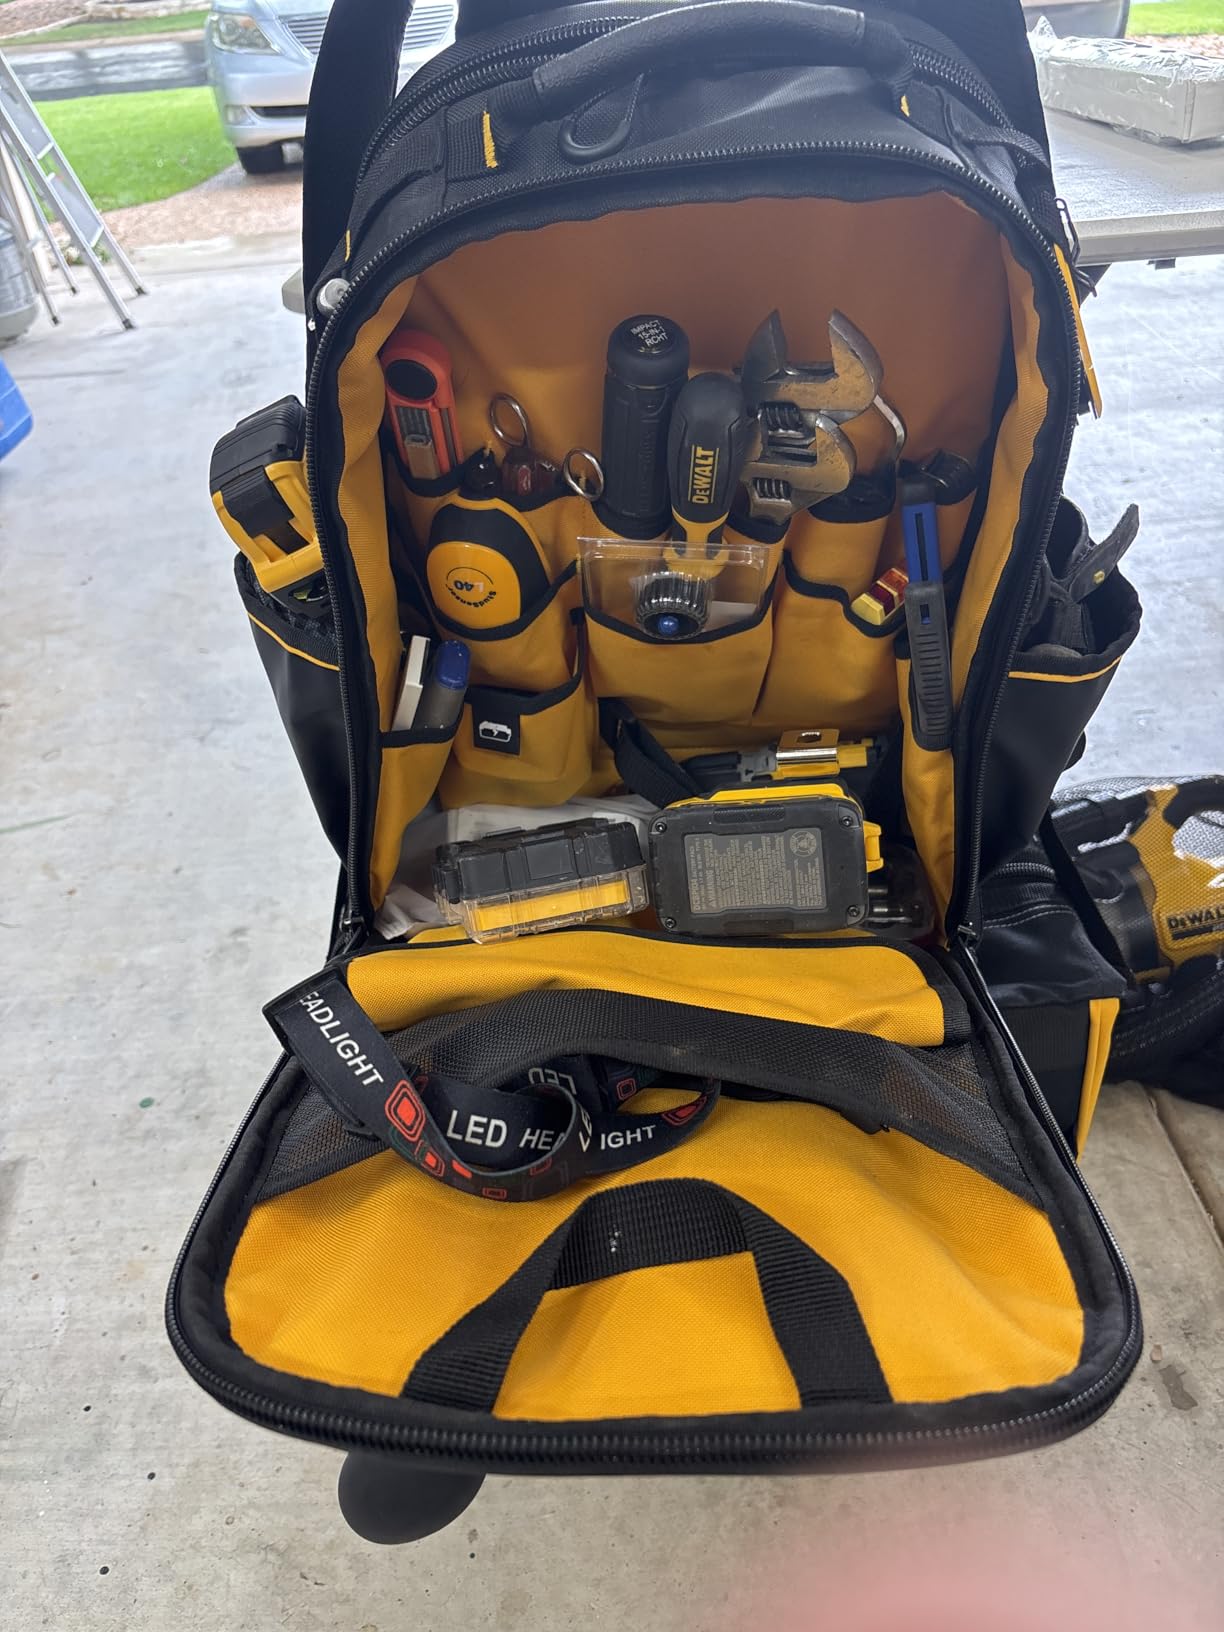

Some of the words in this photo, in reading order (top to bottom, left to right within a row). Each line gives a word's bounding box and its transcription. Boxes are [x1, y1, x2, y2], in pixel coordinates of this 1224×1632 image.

[631, 319, 661, 335] IMPACT
[637, 326, 665, 341] 15-IN-1
[645, 333, 669, 347] RCHT
[1168, 908, 1224, 929] DEWAL
[299, 991, 384, 1087] EADLIGHT
[446, 1110, 508, 1149] LED
